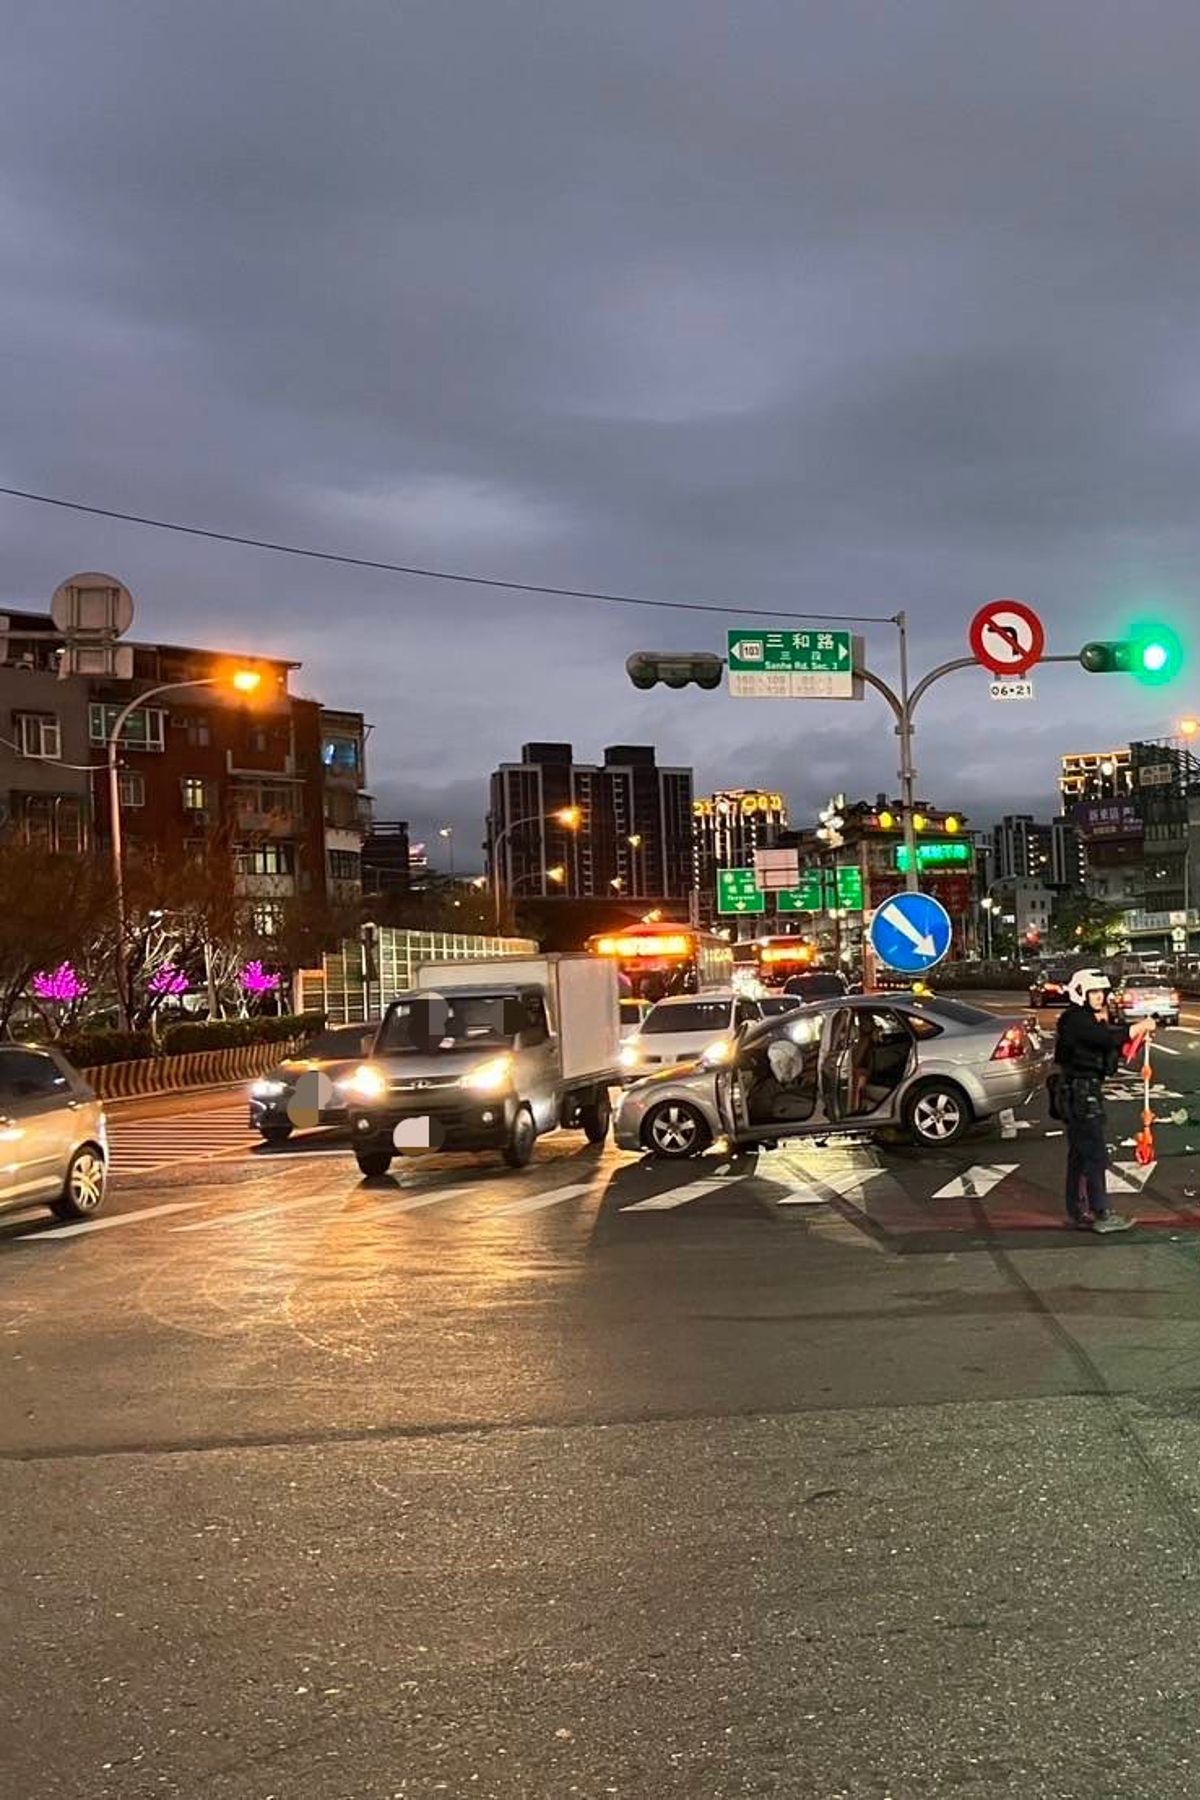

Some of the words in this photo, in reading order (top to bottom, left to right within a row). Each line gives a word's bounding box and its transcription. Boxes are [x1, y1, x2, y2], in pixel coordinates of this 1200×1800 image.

[766, 633, 834, 649] 三和路
[780, 651, 821, 660] 三段
